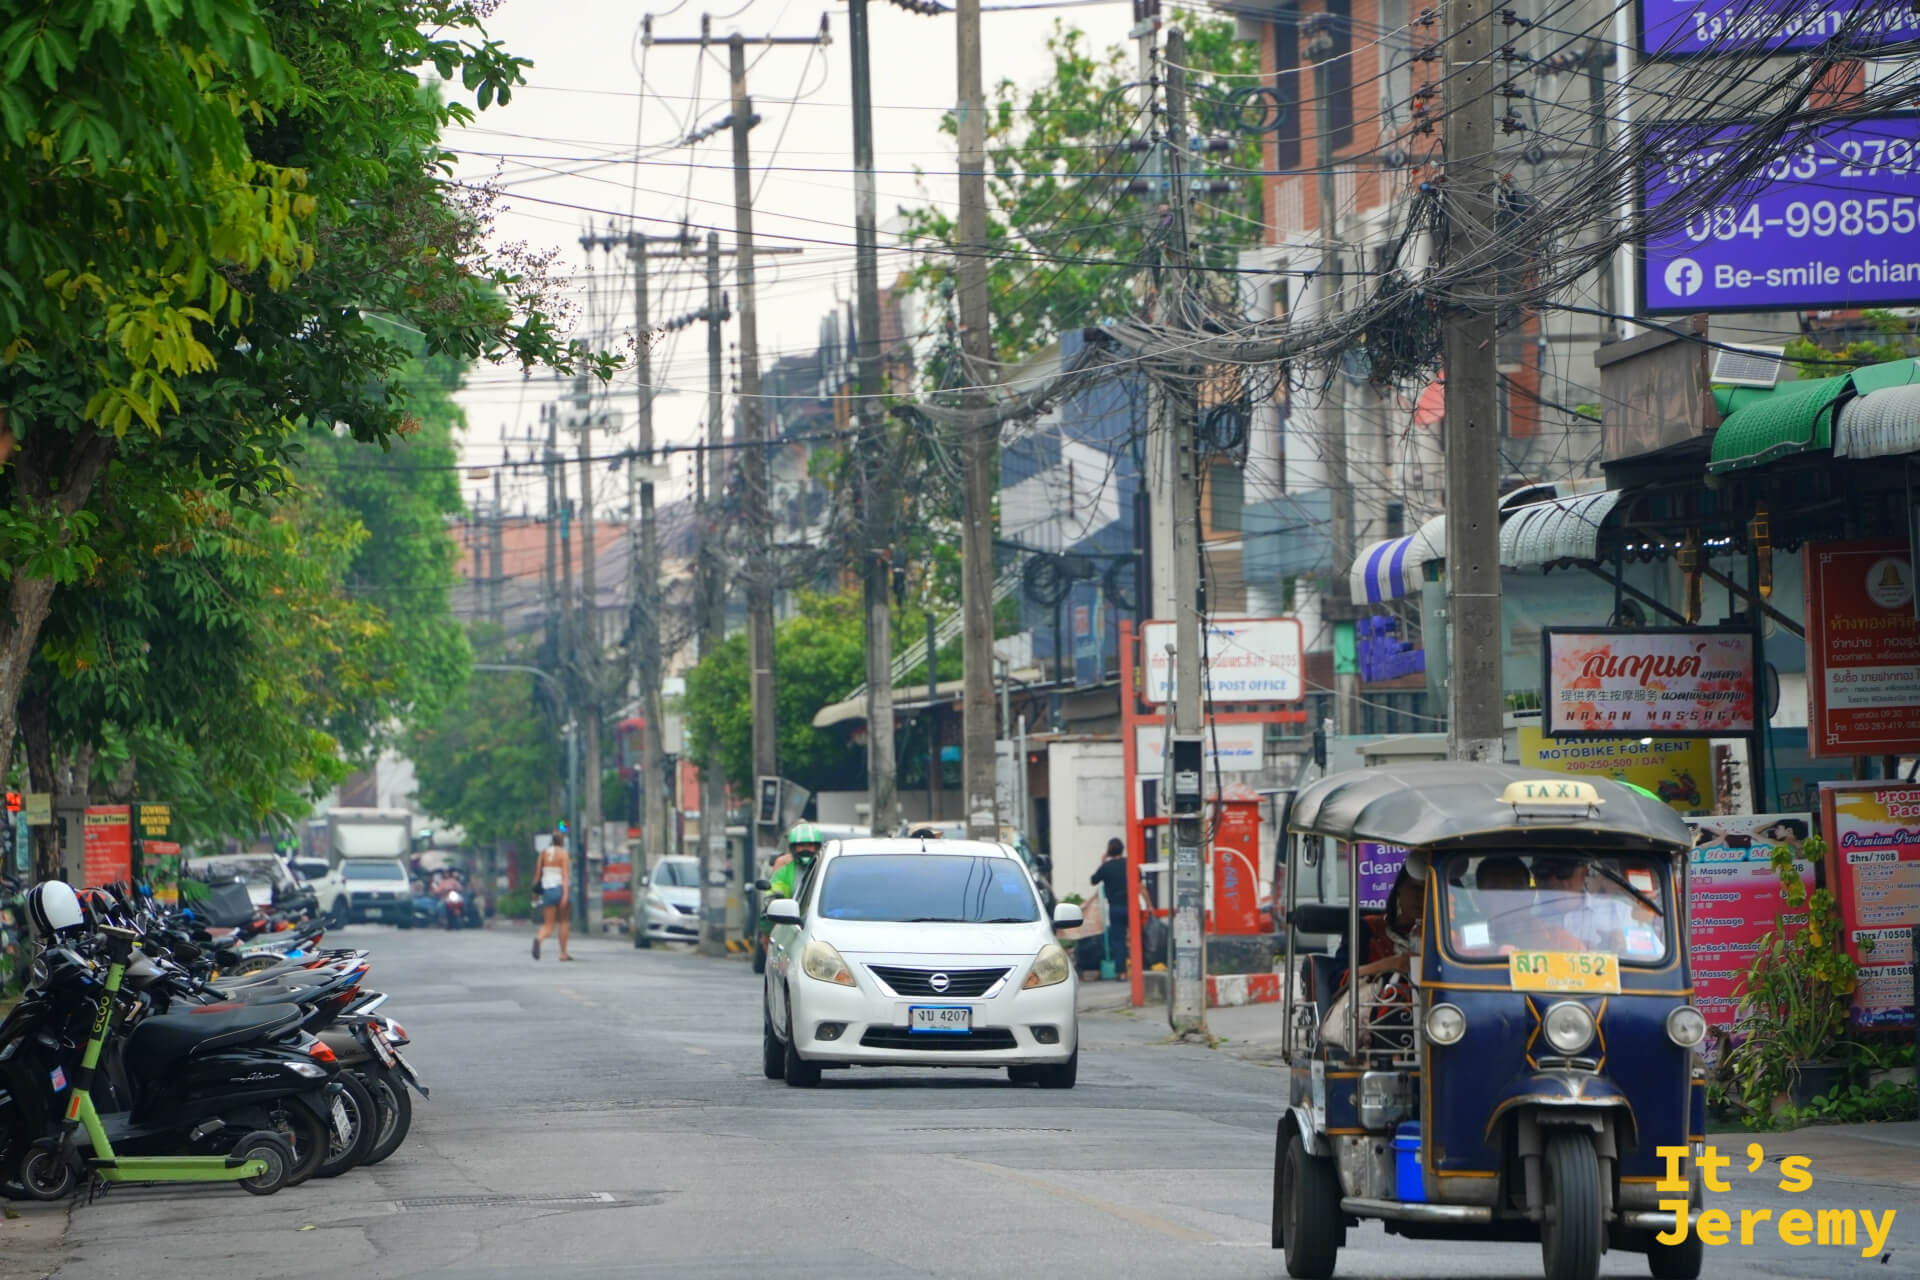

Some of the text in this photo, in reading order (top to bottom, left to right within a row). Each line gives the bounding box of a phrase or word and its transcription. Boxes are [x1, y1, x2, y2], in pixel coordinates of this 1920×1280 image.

[1685, 197, 1920, 241] 084-99855
[1714, 261, 1840, 288] Be-smile
[1218, 680, 1245, 691] POST
[1249, 679, 1287, 690] OFFICE
[1560, 688, 1658, 702] 提供养生按摩服务
[1566, 711, 1632, 721] NAKAN
[1539, 741, 1692, 760] MOTOBIKE FOR RENT
[1566, 758, 1632, 770] 200-250-500
[1643, 757, 1666, 767] DAY
[1523, 784, 1580, 798] TAXI
[1843, 832, 1892, 848] Premium
[1706, 849, 1745, 860] Hour
[1700, 867, 1739, 876] Massage
[1702, 892, 1740, 902] Massage
[1705, 918, 1744, 928] Massage
[940, 1010, 968, 1021] 4207
